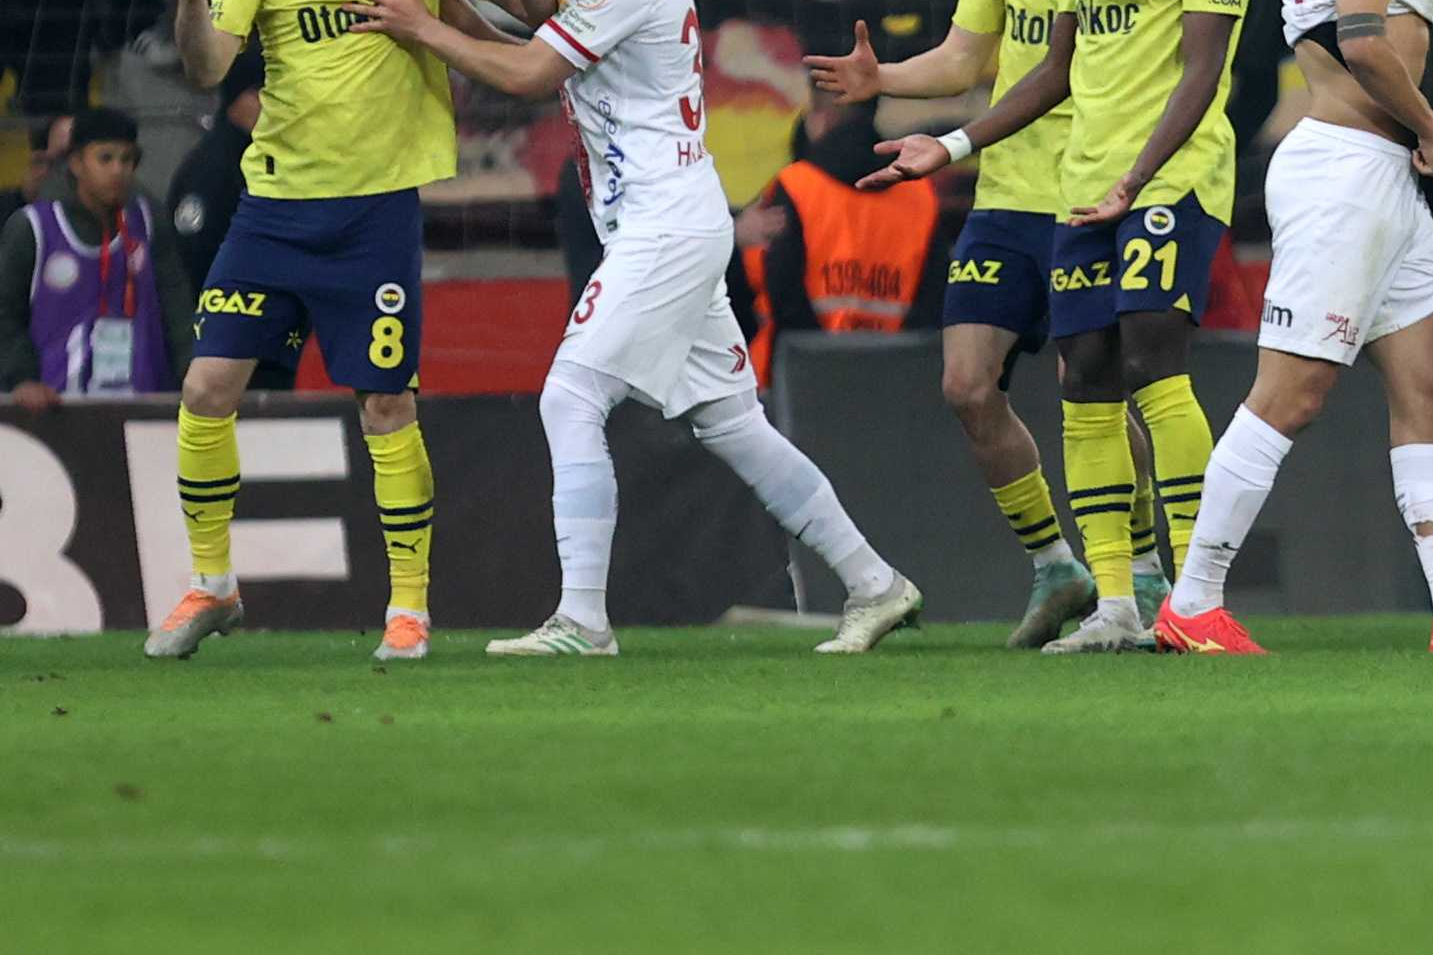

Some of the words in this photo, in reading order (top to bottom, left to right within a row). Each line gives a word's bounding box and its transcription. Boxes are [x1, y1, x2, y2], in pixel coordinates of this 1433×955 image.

[1052, 260, 1113, 292] GAZ
[1120, 238, 1178, 292] 21
[368, 315, 405, 370] 8
